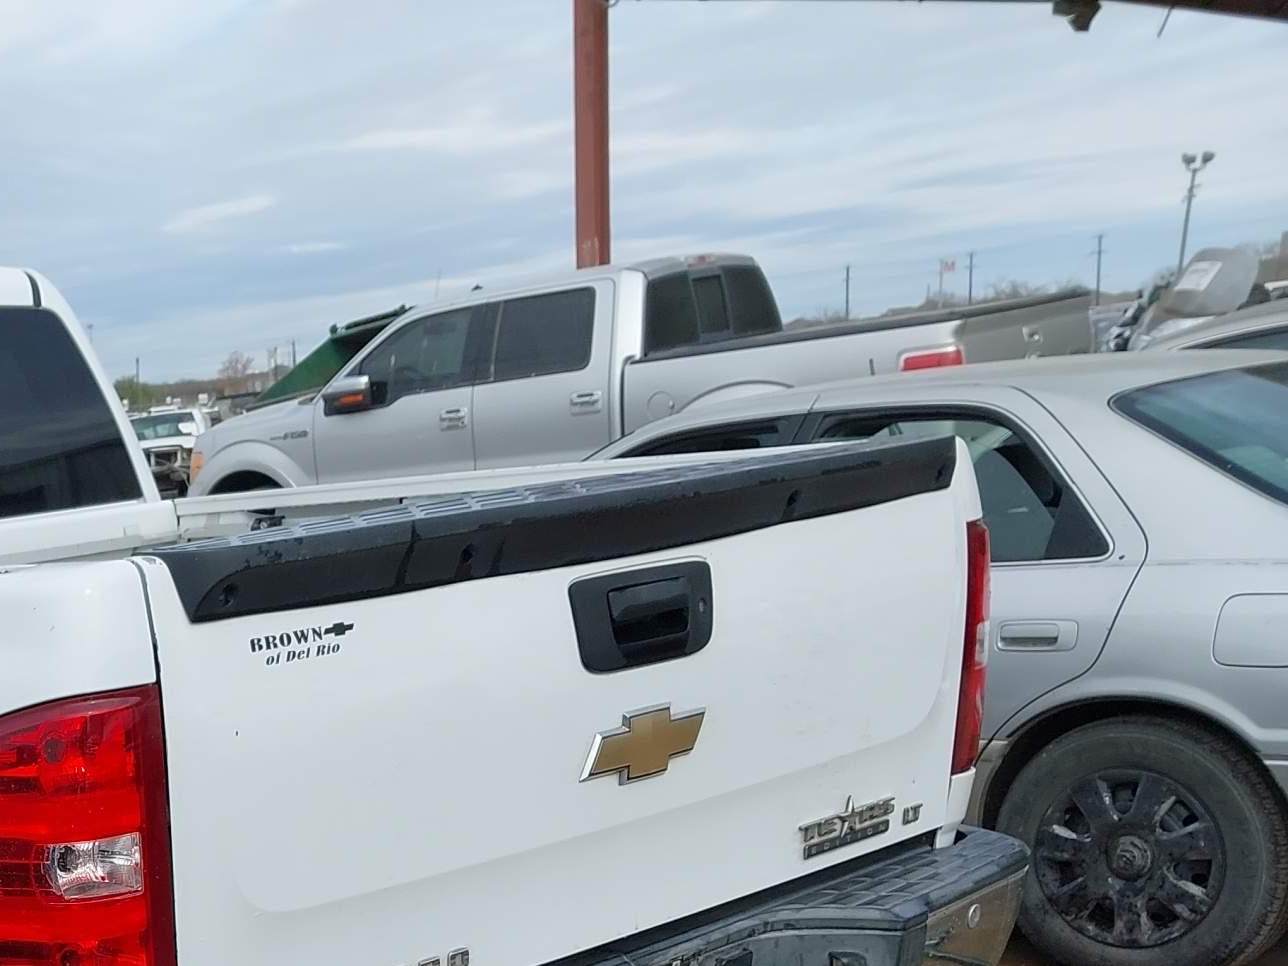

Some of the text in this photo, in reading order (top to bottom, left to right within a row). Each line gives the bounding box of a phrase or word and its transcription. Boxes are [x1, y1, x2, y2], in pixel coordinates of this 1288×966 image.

[250, 627, 323, 652] BROWN
[265, 643, 340, 665] of Del Rio
[902, 803, 923, 826] LT
